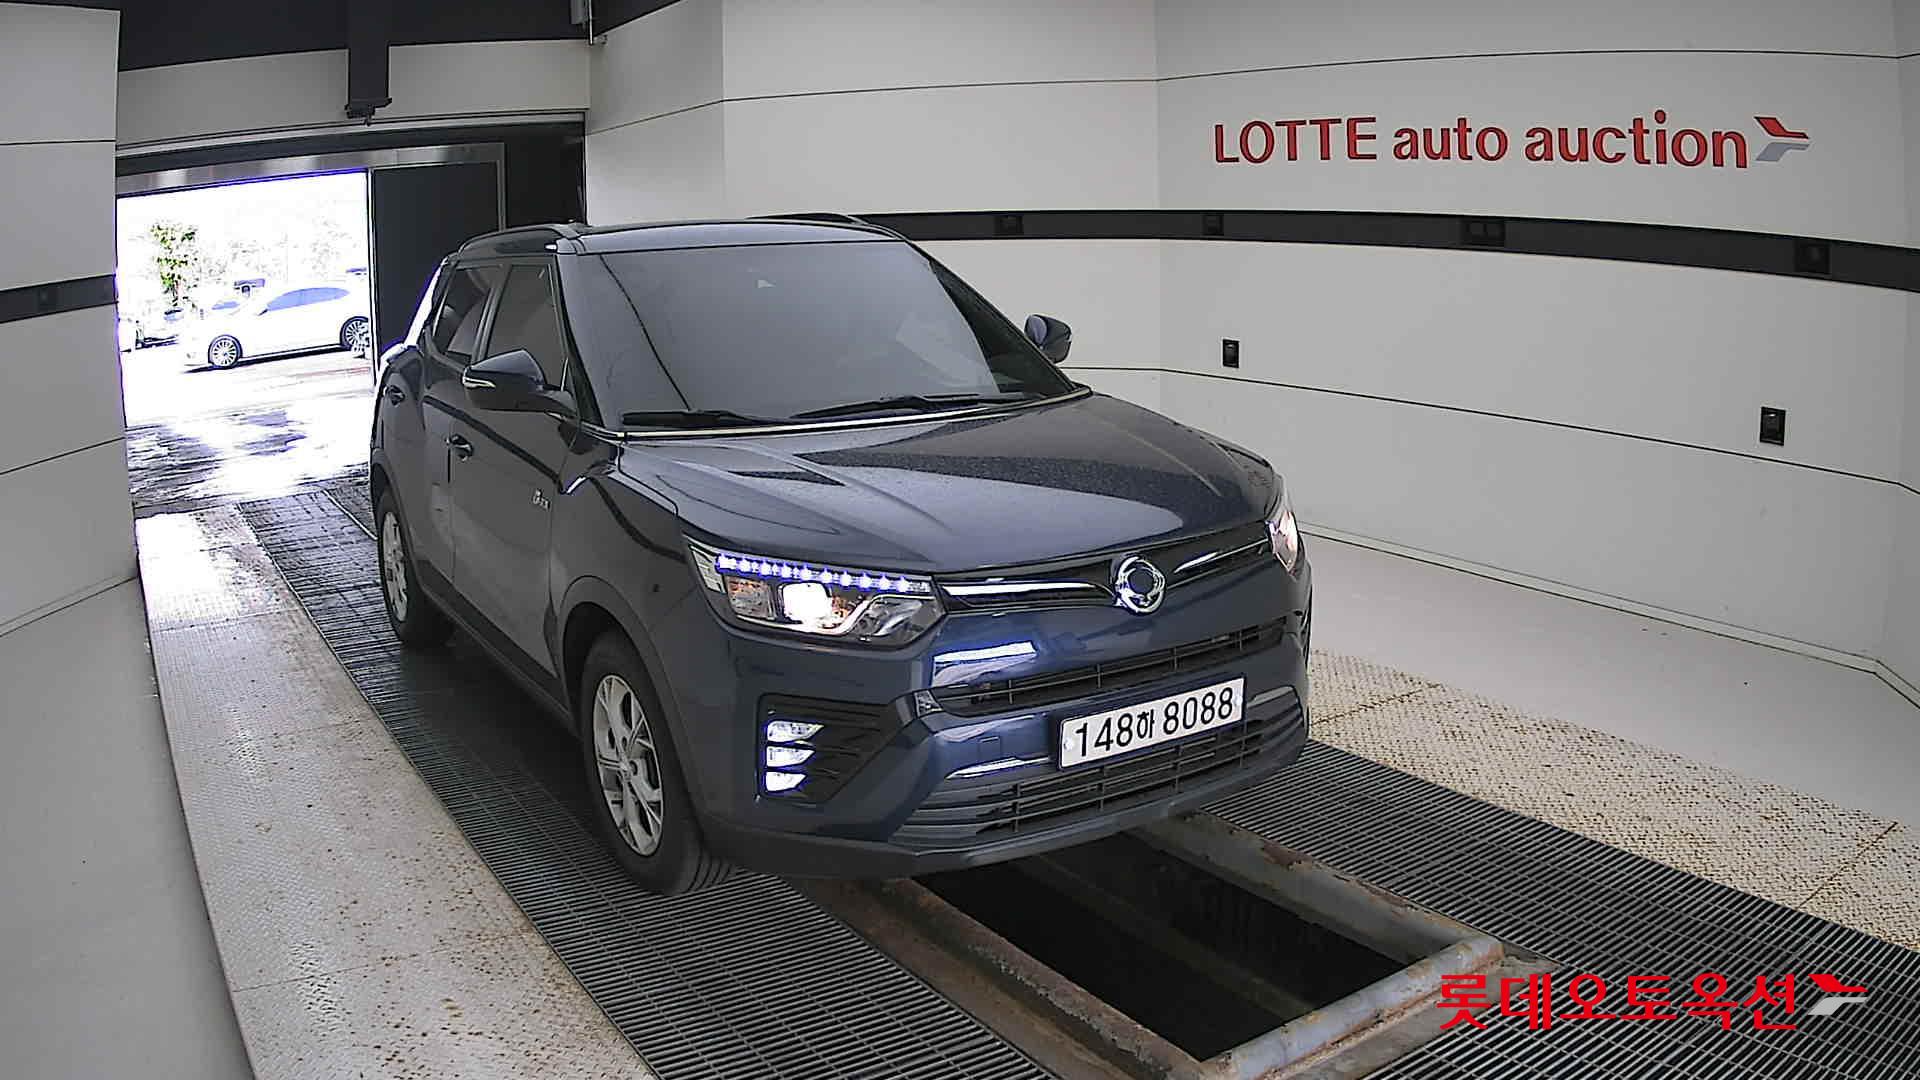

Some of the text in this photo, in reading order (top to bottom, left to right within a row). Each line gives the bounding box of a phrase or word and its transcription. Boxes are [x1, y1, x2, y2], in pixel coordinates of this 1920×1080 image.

[1214, 109, 1748, 169] LOTTE auto auction
[1075, 687, 1233, 757] 148하 8088
